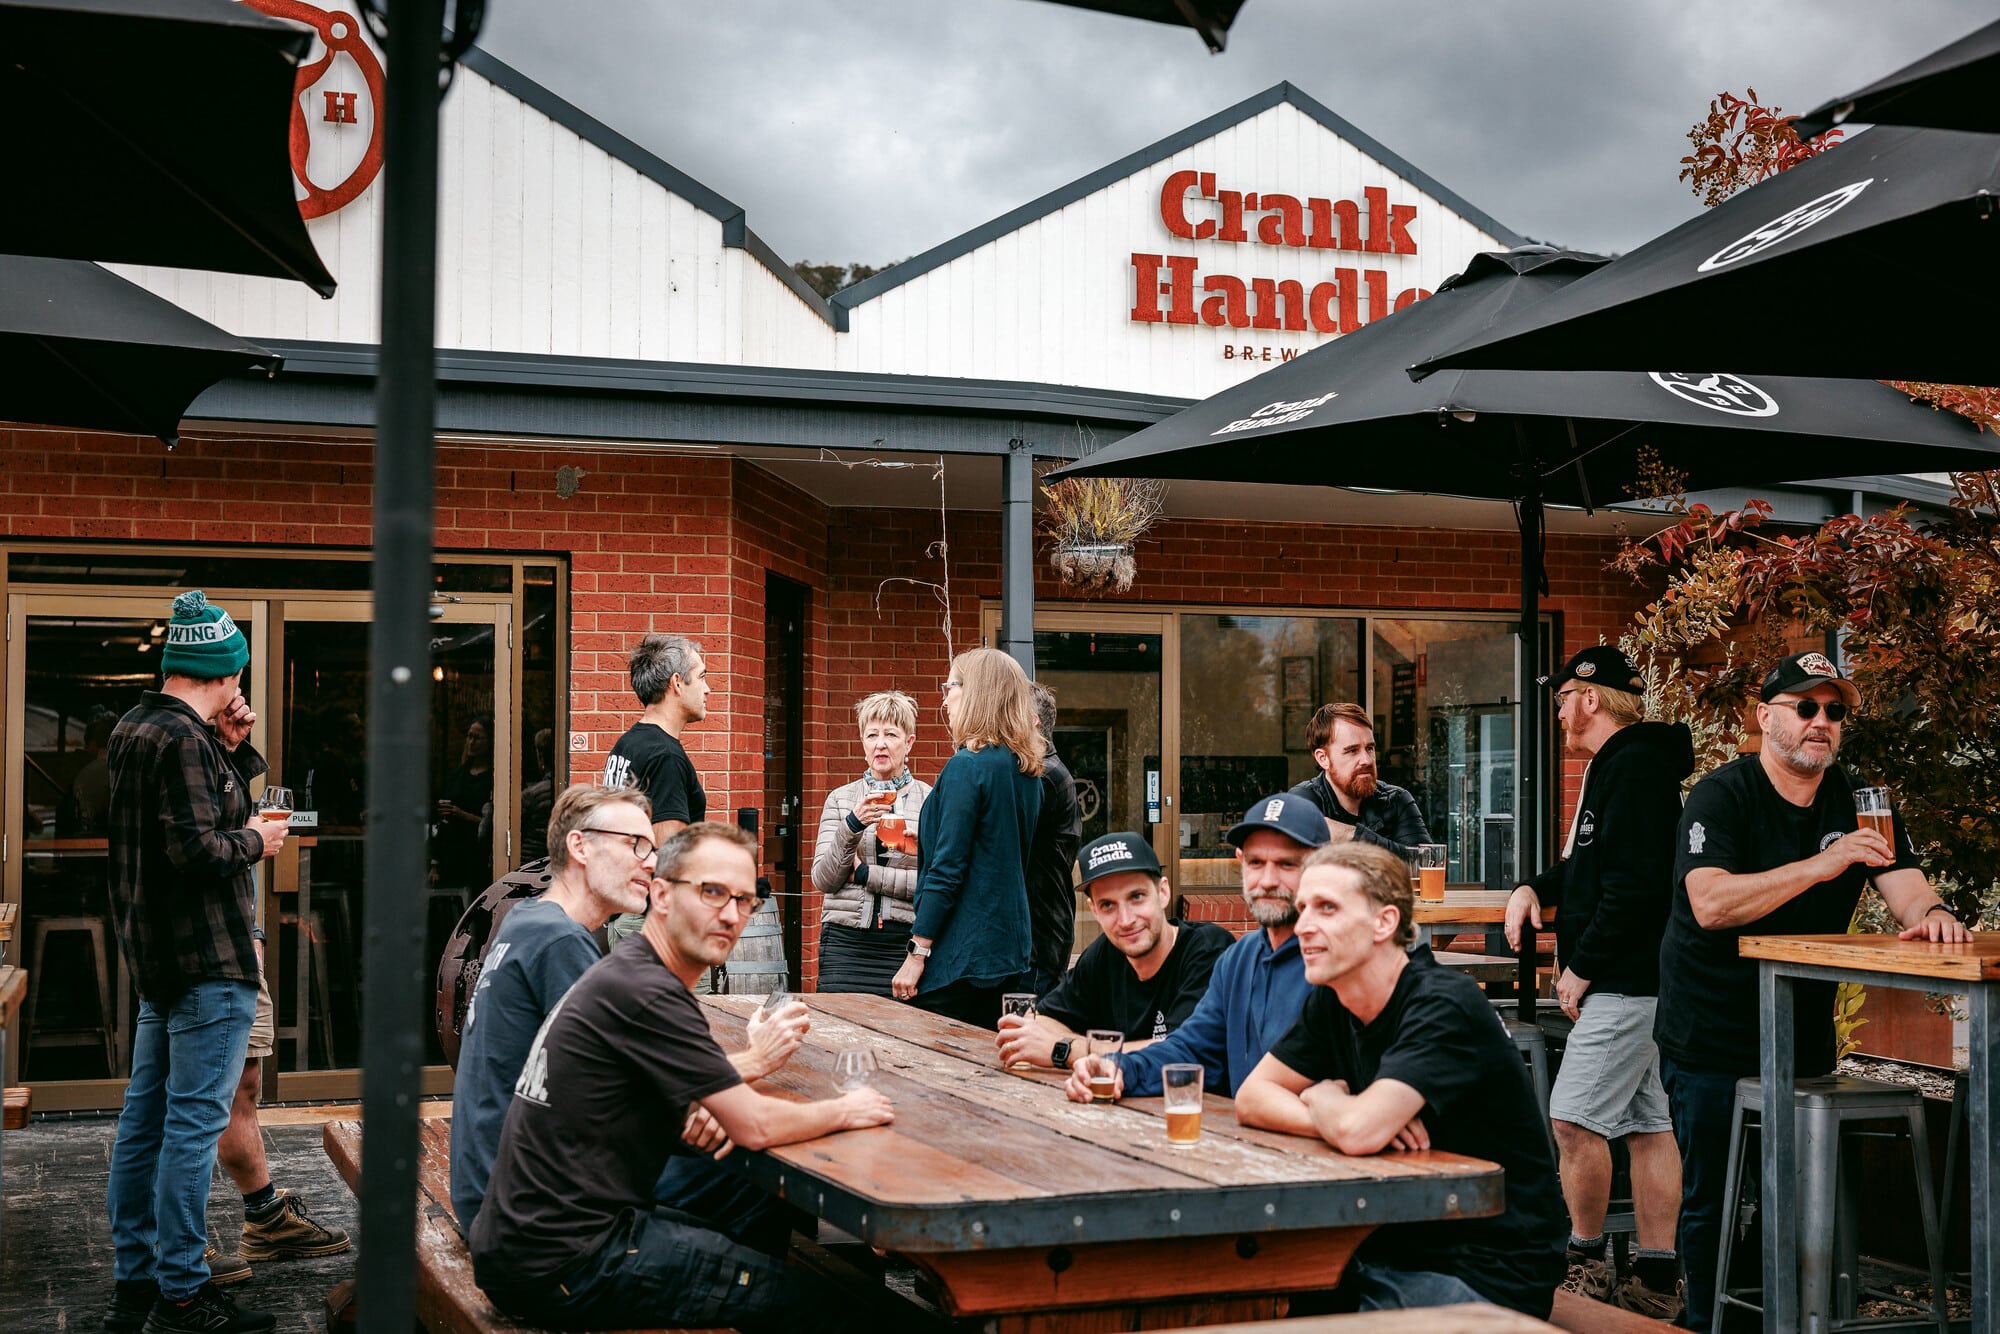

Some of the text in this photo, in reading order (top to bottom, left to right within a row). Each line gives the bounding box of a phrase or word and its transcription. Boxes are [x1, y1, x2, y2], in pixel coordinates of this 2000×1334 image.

[1160, 170, 1417, 256] Crank
[1224, 345, 1312, 362] BREW
[1250, 391, 1340, 418] Crank
[1209, 408, 1315, 436] Handle
[292, 815, 313, 823] PULL
[1090, 840, 1128, 859] Crank
[1087, 850, 1134, 871] Handle
